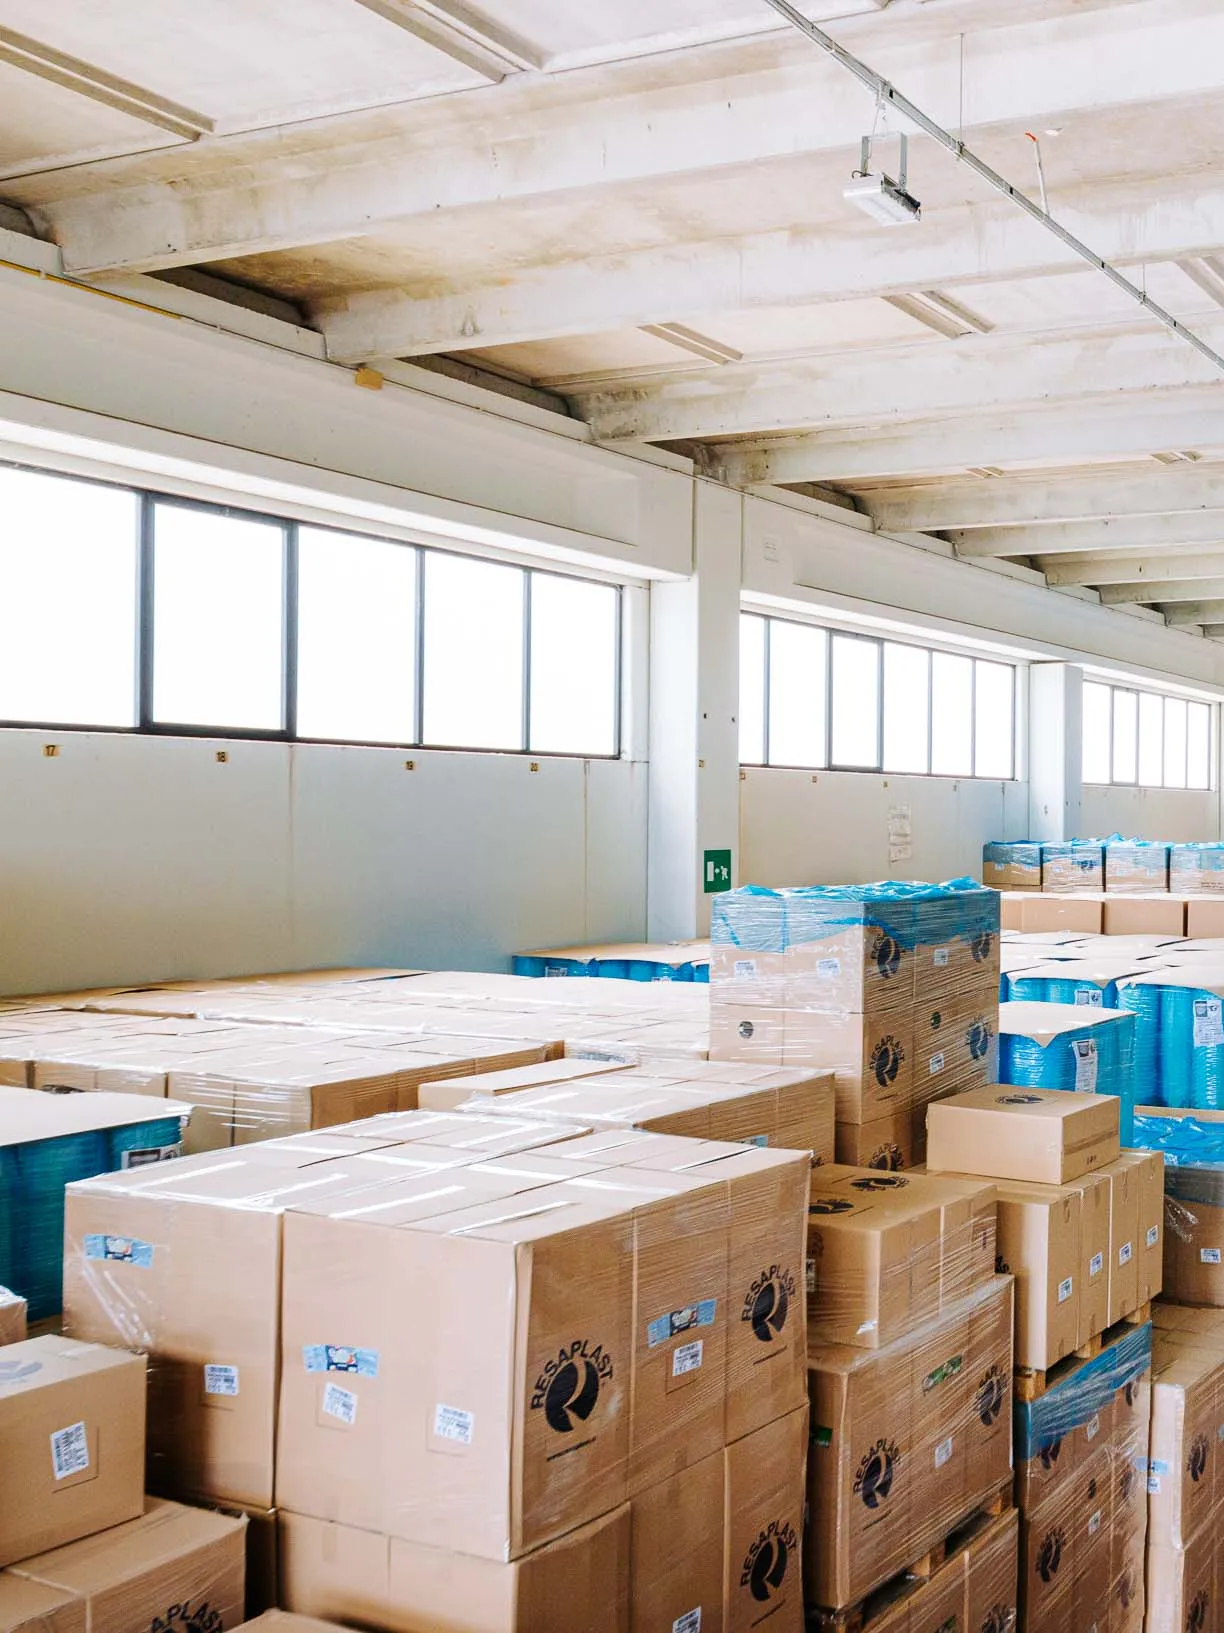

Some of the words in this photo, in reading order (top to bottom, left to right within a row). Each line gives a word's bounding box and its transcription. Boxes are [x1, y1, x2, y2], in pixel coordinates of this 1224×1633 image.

[741, 1263, 796, 1323] RESAPLAST
[530, 1339, 614, 1410] RESAPLAST
[739, 1519, 798, 1588] RESAPLAST
[150, 1599, 224, 1633] APLAST
